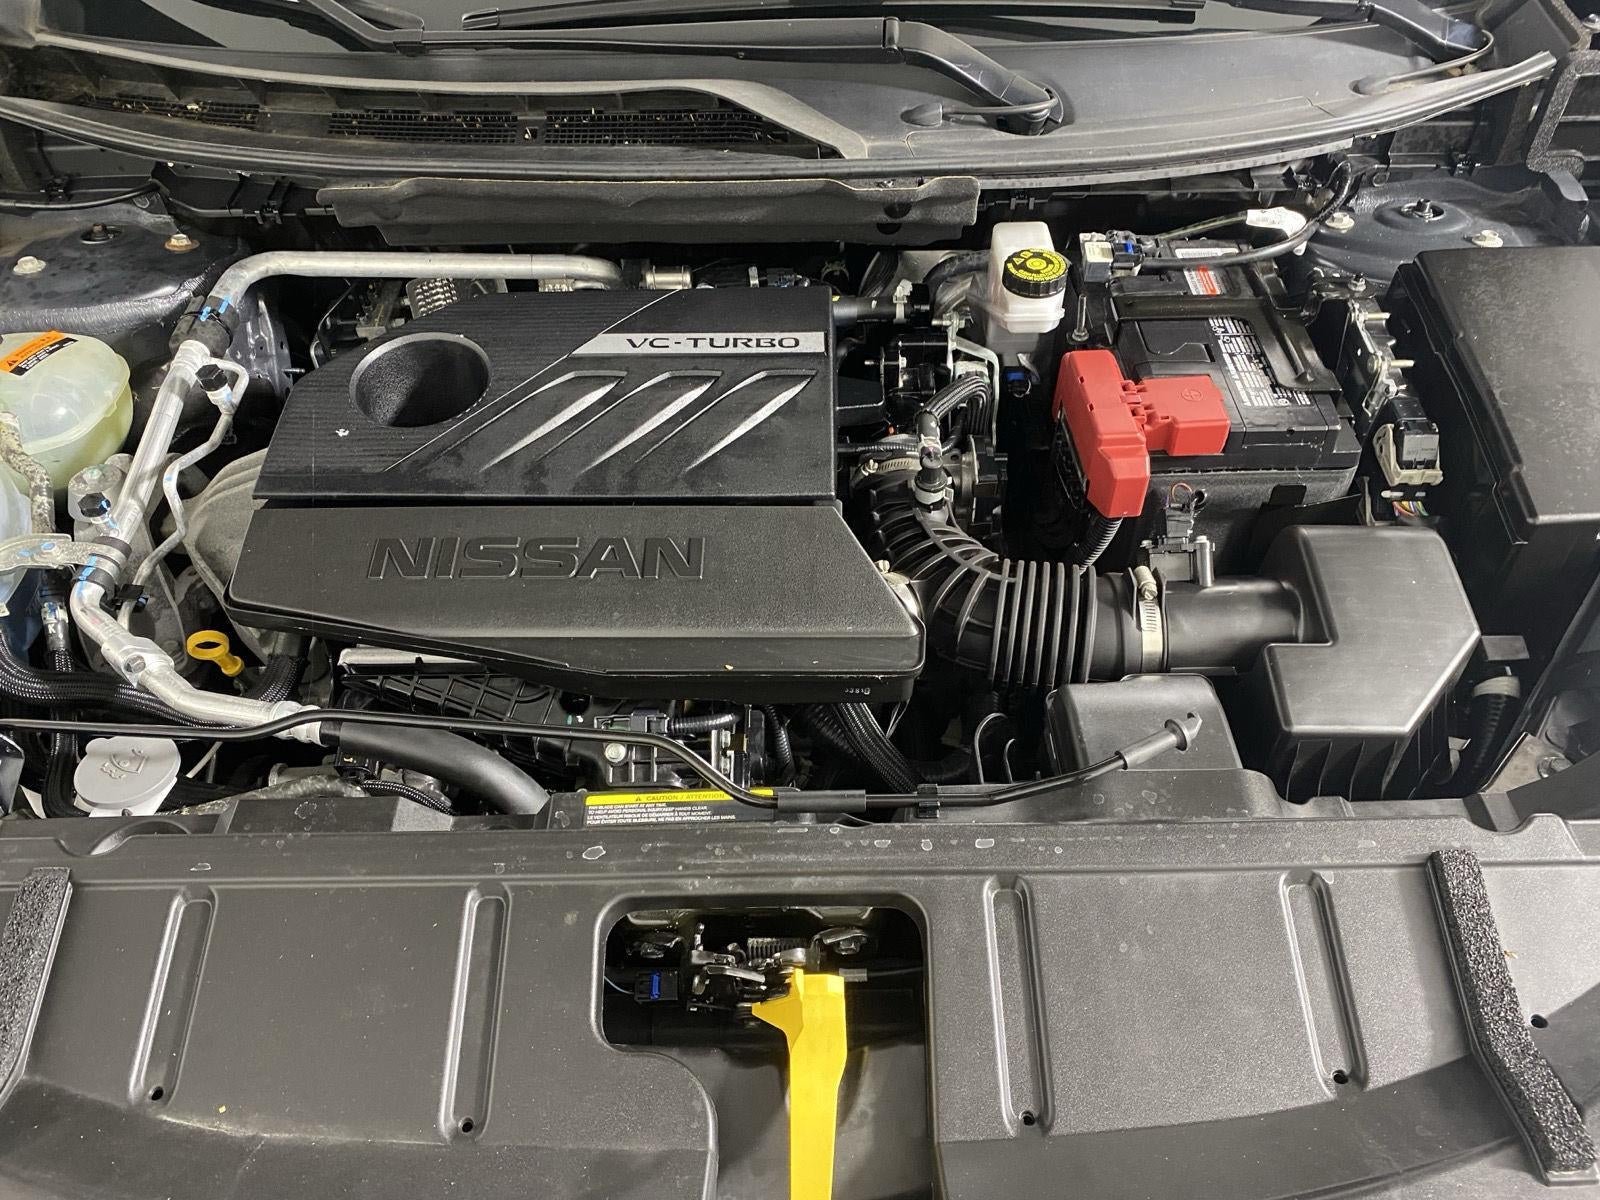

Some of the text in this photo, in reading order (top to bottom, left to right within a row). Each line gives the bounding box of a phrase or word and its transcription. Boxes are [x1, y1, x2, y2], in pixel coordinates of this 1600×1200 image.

[626, 337, 801, 349] VC-TURBO
[367, 536, 706, 579] NISSAN
[646, 794, 678, 802] CAUTION
[686, 792, 725, 800] ATTENTION
